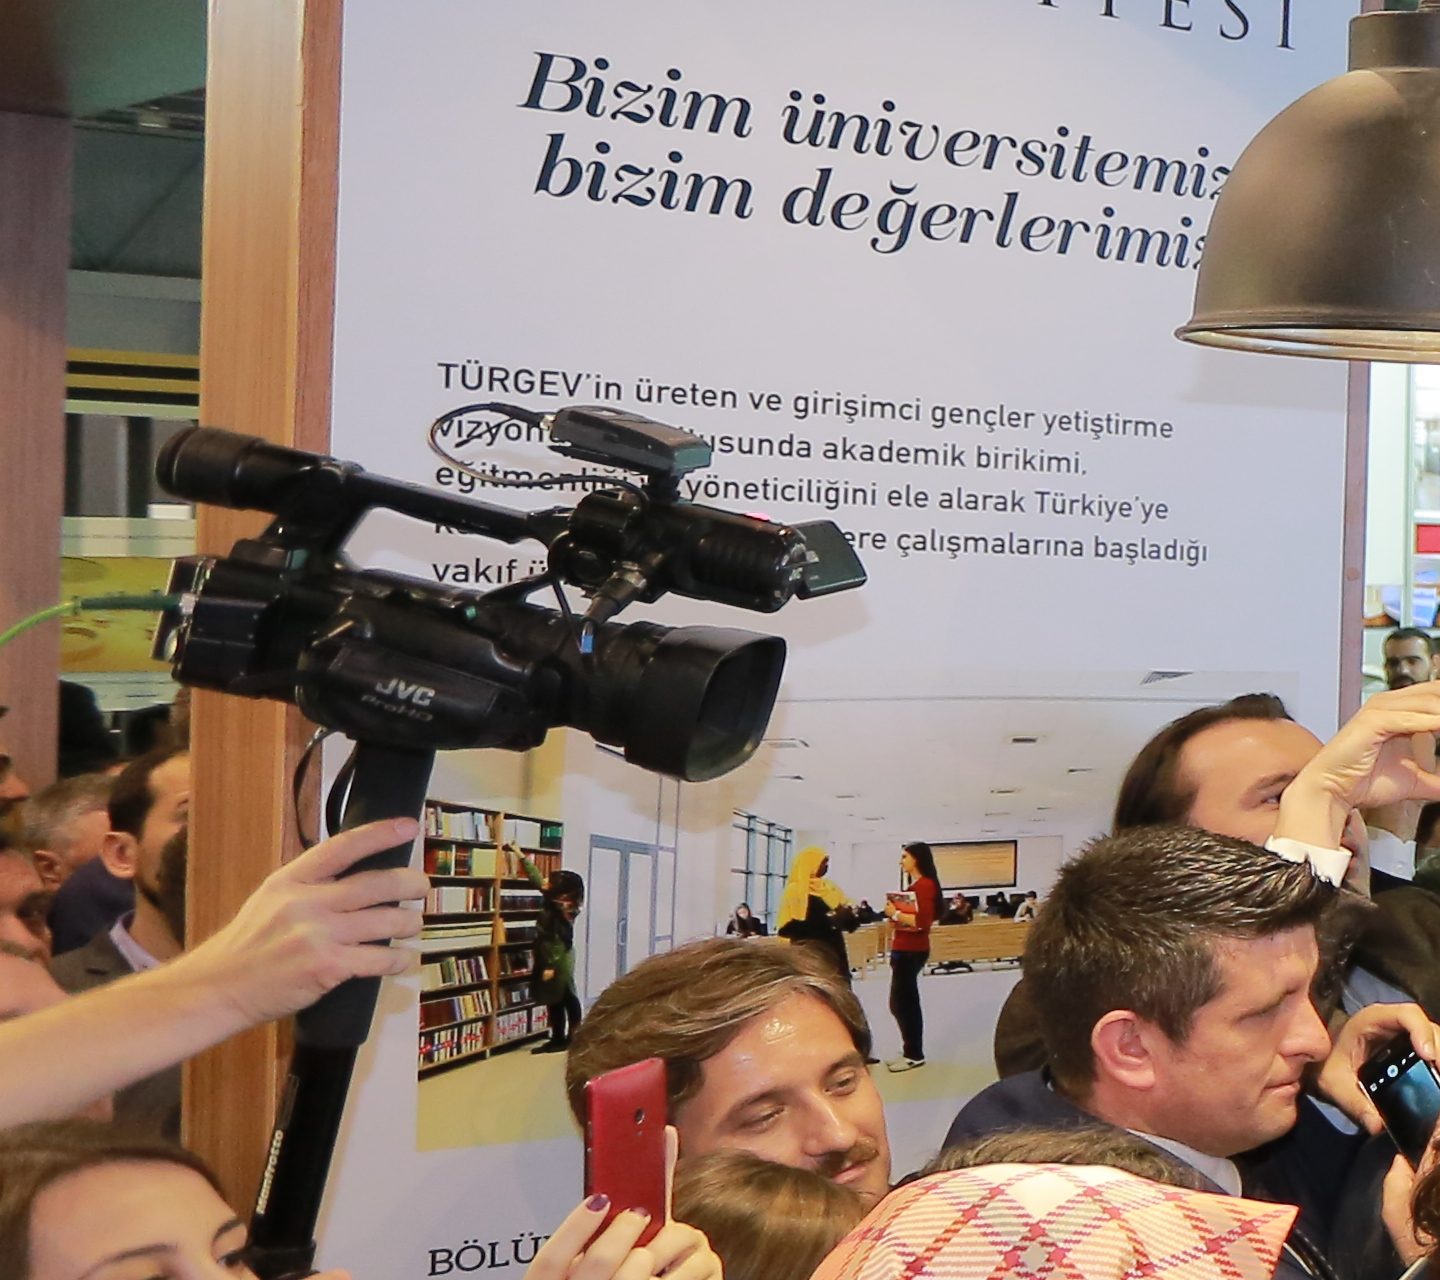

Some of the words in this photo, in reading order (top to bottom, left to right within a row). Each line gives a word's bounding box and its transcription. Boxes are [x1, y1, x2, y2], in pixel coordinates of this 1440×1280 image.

[517, 51, 754, 138] Bizim
[533, 132, 755, 220] bizim
[437, 360, 622, 402] TÜRGEV'in
[635, 377, 738, 410] üreten
[749, 391, 783, 412] ve
[793, 390, 921, 424] girişimci
[931, 404, 1036, 434] gençler
[1043, 410, 1175, 441] yetiştirme
[822, 437, 967, 469] akademik
[684, 475, 877, 511] yöneticiliğini
[887, 483, 929, 509] ele
[938, 486, 1026, 515] alarak
[1034, 490, 1170, 524] Türkiye'ye
[432, 556, 519, 584] vakıf
[896, 528, 1085, 560] çalışmalarına
[1094, 536, 1209, 568] başladığı
[375, 678, 436, 707] JVC
[427, 1232, 552, 1278] BÖLÜ
